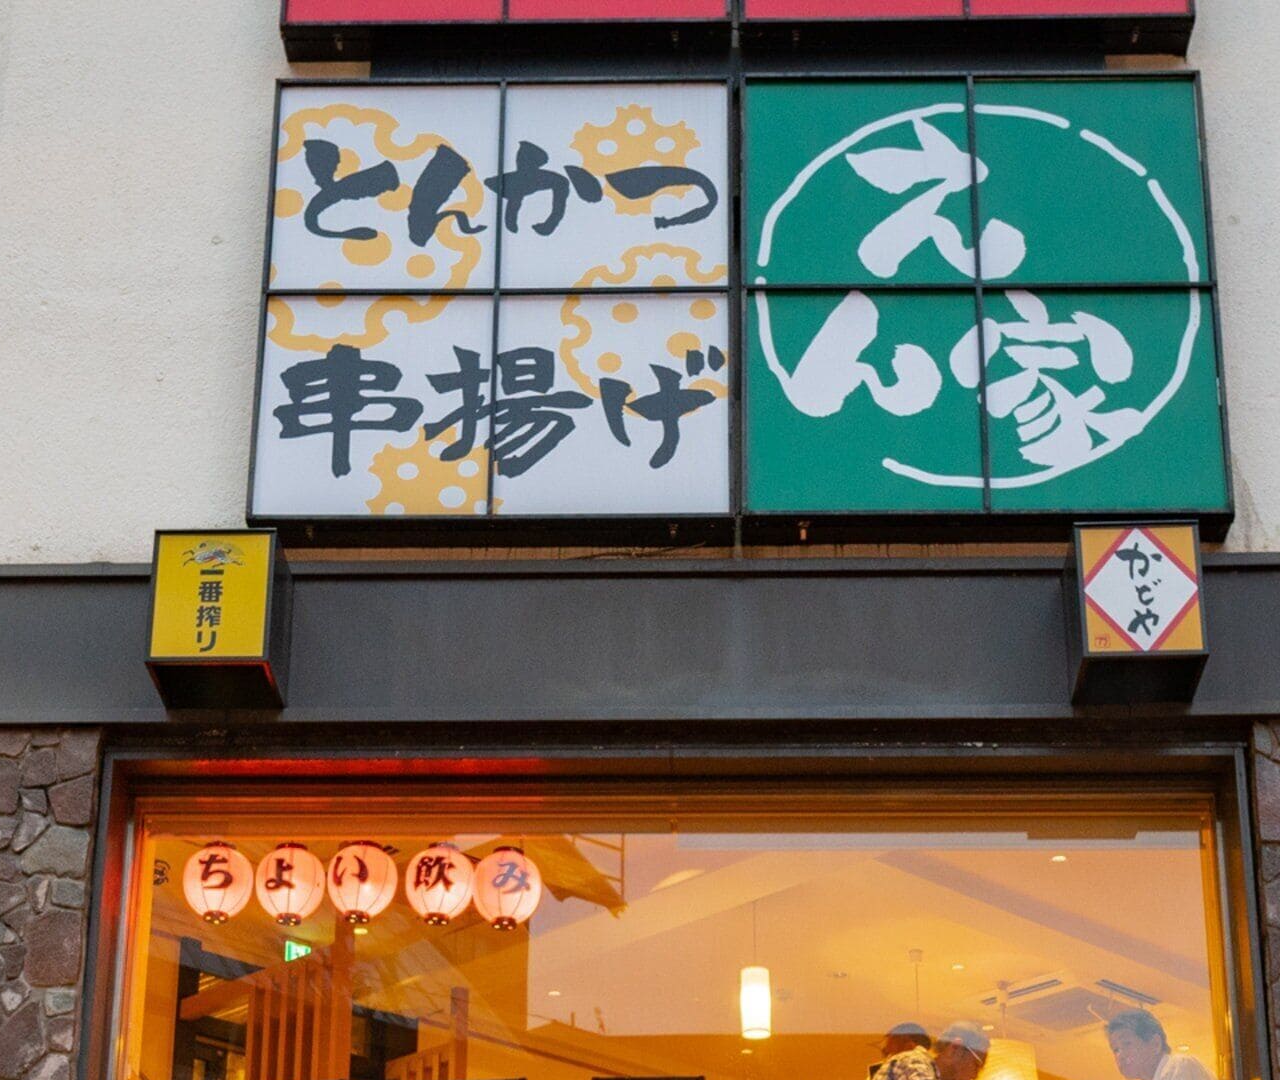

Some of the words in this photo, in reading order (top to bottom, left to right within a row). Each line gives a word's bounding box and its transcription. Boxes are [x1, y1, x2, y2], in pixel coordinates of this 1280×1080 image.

[303, 139, 719, 246] とんかつ
[272, 343, 726, 479] 串揚げ
[195, 569, 224, 652] 一番搾り
[1115, 542, 1162, 636] かどや
